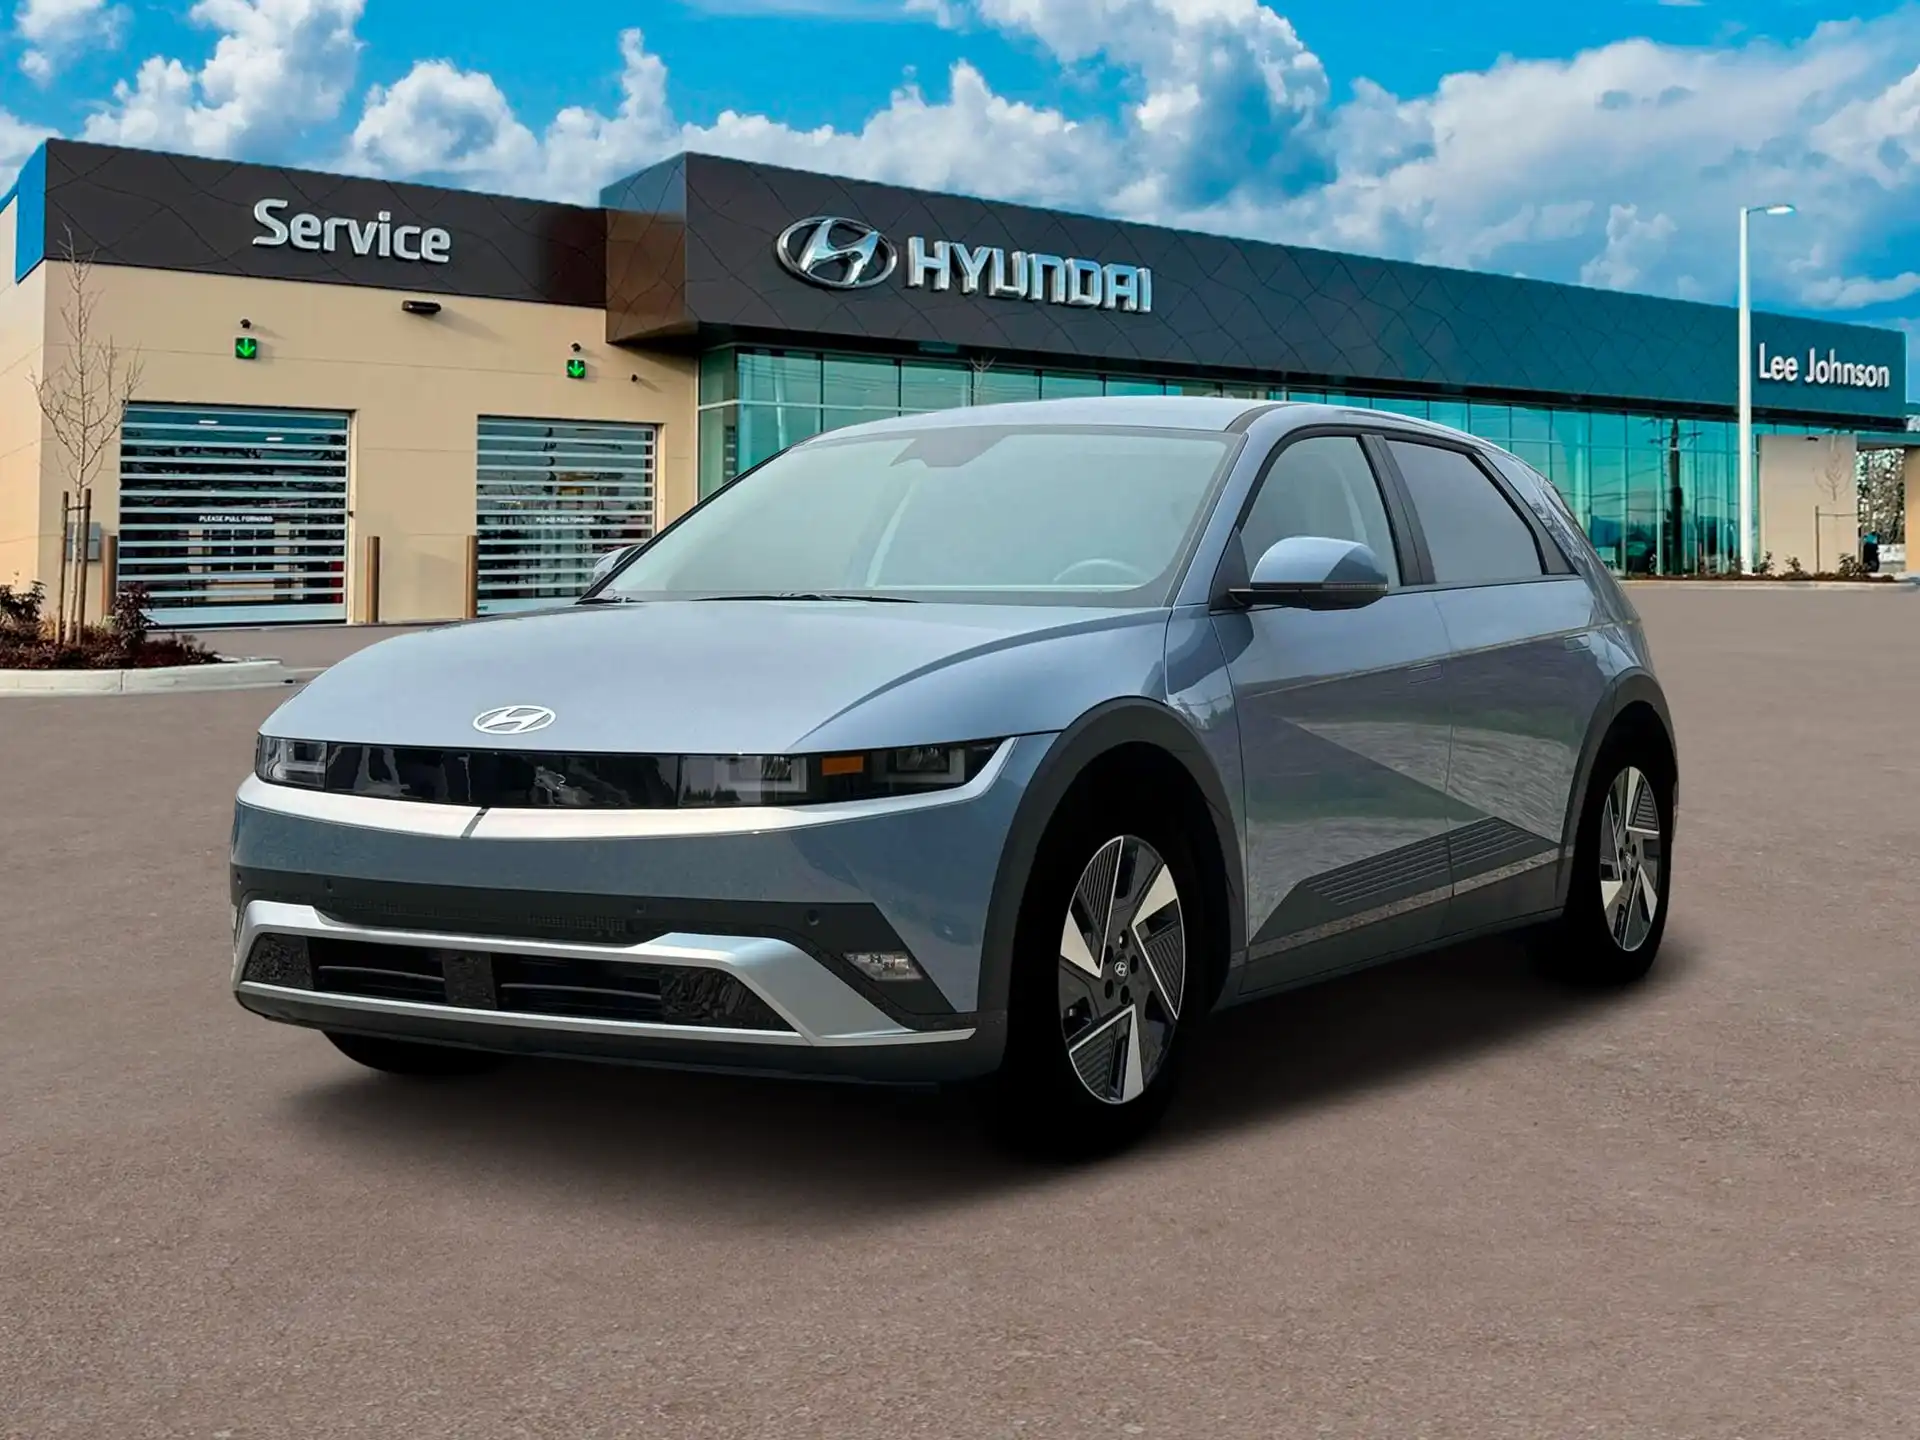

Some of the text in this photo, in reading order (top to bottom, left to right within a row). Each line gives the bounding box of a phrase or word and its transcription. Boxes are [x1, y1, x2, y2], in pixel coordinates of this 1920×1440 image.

[252, 199, 450, 263] Service
[908, 236, 1152, 313] HYUNDAI
[1759, 342, 1890, 388] Lee Johnson
